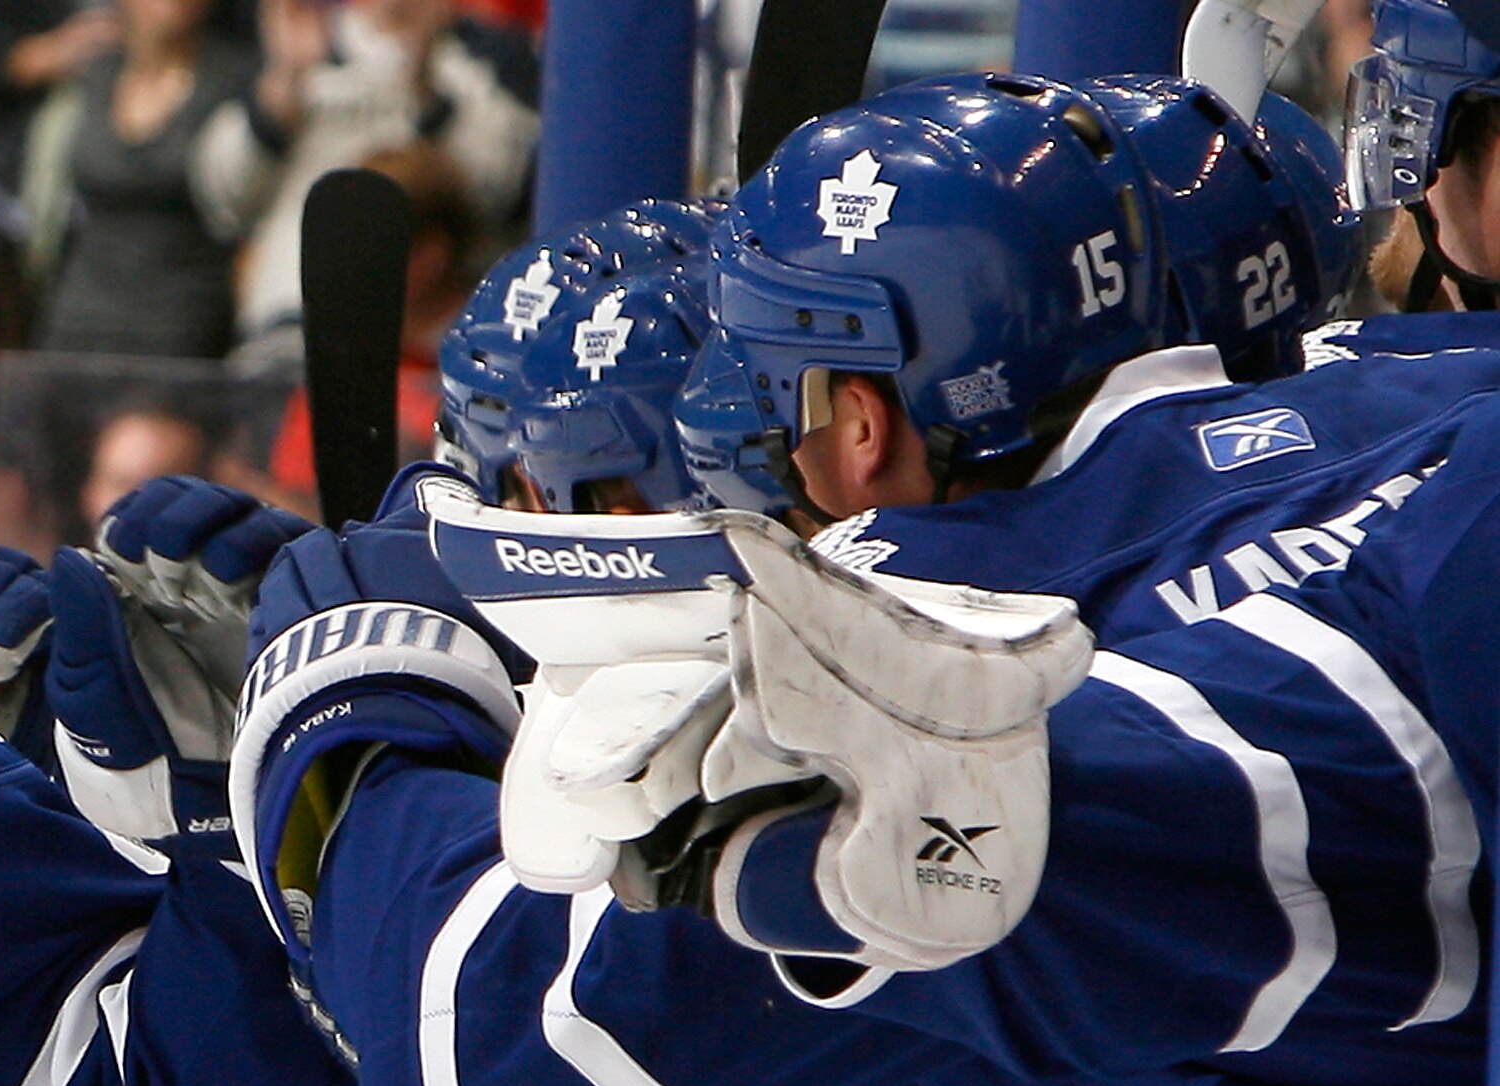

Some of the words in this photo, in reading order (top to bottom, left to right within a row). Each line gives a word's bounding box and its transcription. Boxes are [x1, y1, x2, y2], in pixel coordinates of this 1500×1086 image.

[831, 193, 878, 206] TORONTO
[836, 205, 867, 217] MAPLE
[836, 216, 865, 229] LEAFS
[1071, 229, 1126, 318] 15
[1236, 240, 1297, 330] 22
[494, 538, 666, 580] Reebok
